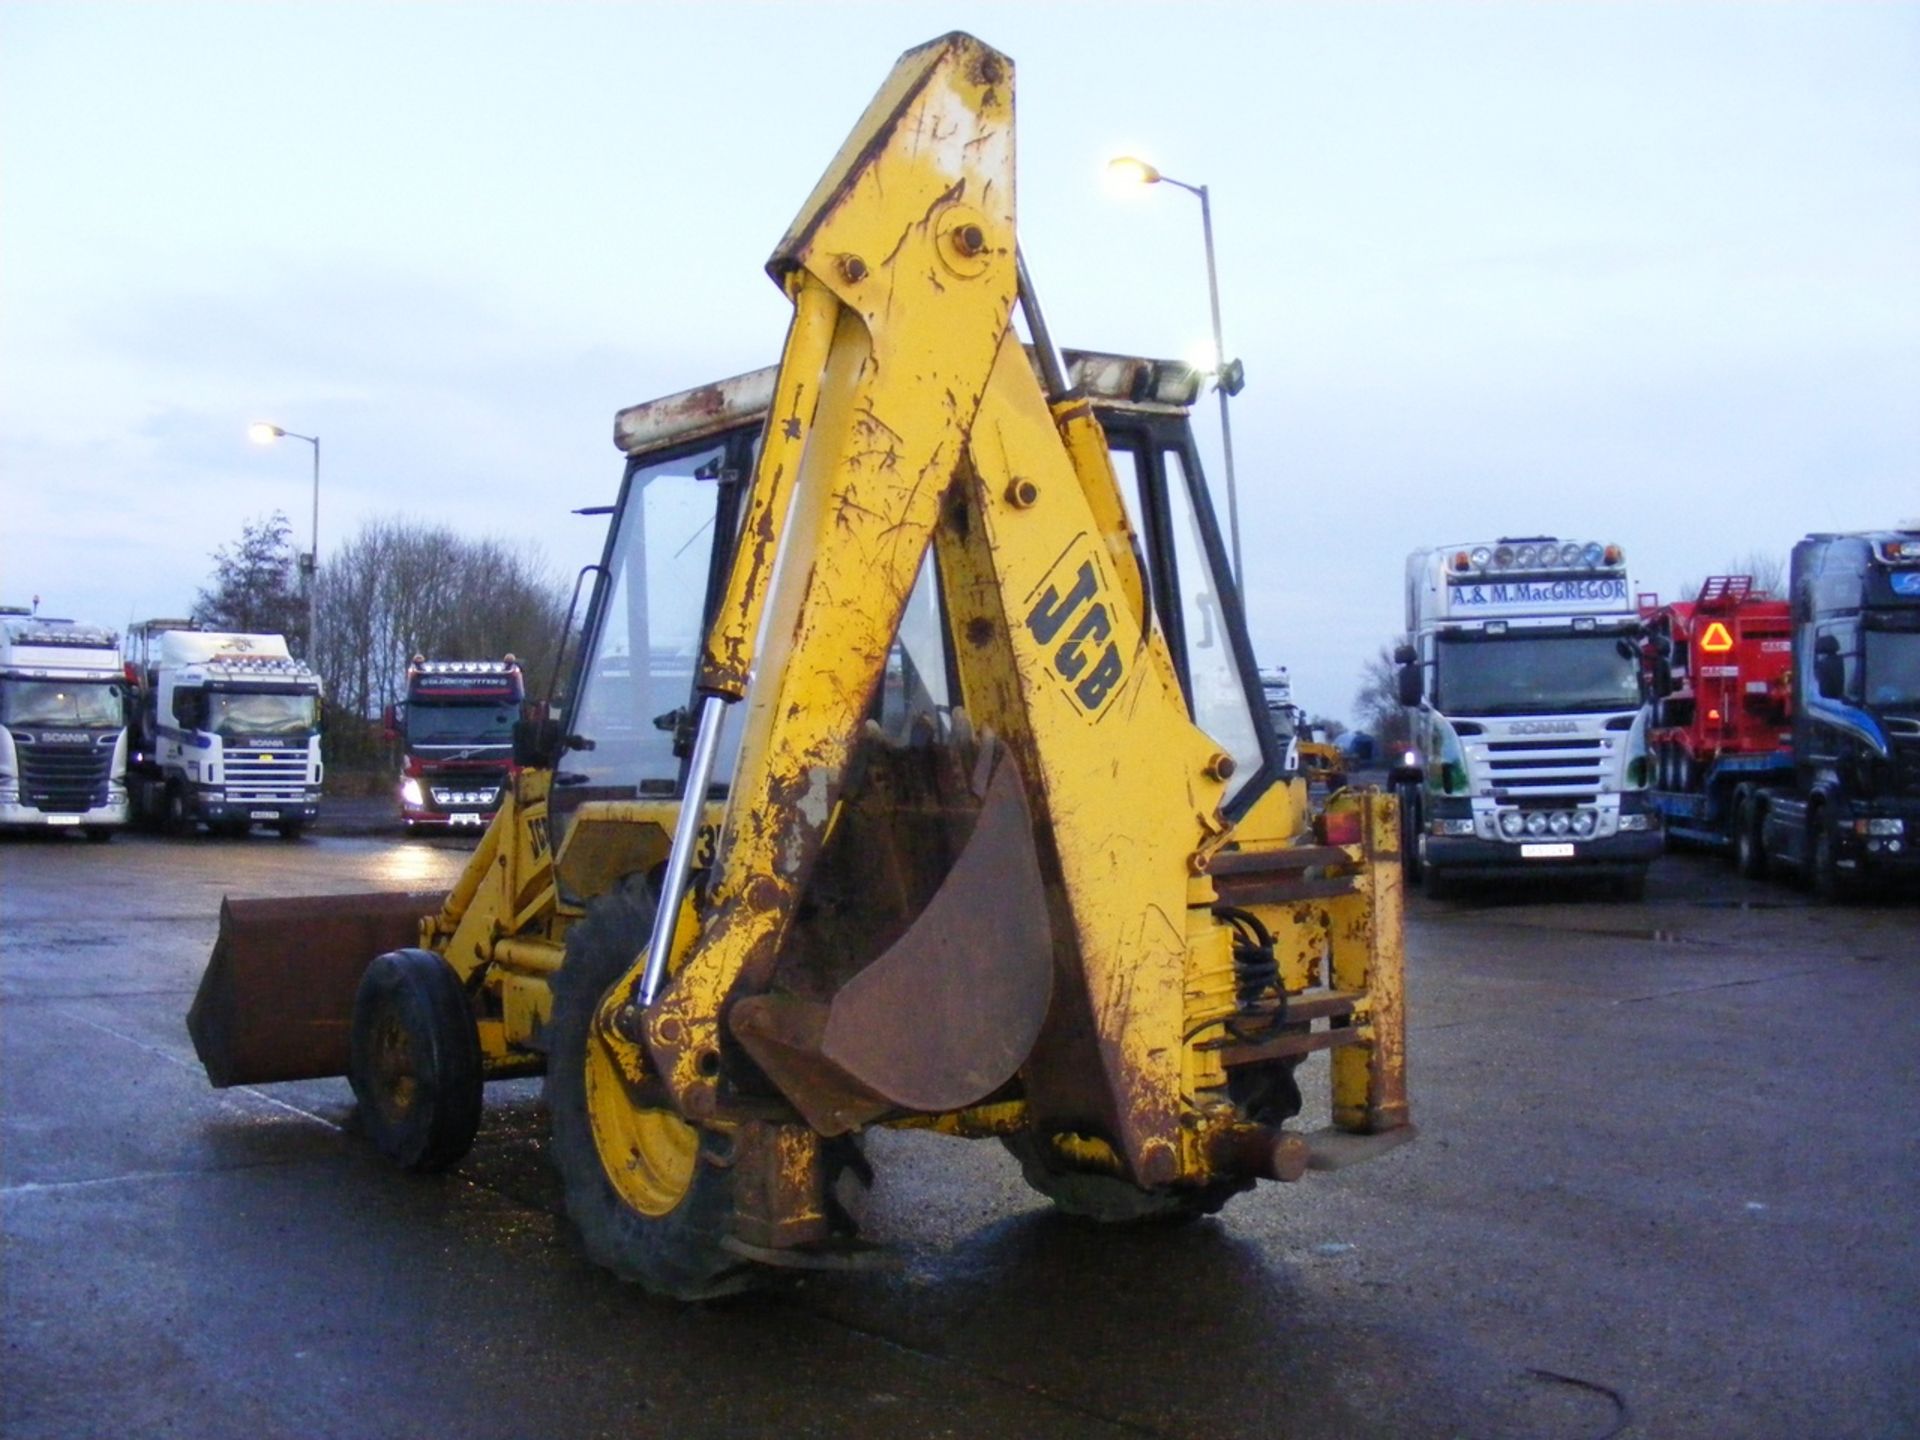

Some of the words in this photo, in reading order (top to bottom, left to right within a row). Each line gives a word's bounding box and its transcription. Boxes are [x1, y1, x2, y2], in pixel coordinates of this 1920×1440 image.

[1025, 559, 1123, 710] JCB
[1509, 721, 1579, 735] SCANIA
[41, 732, 91, 743] SCANIA
[249, 740, 284, 748] SCANIA
